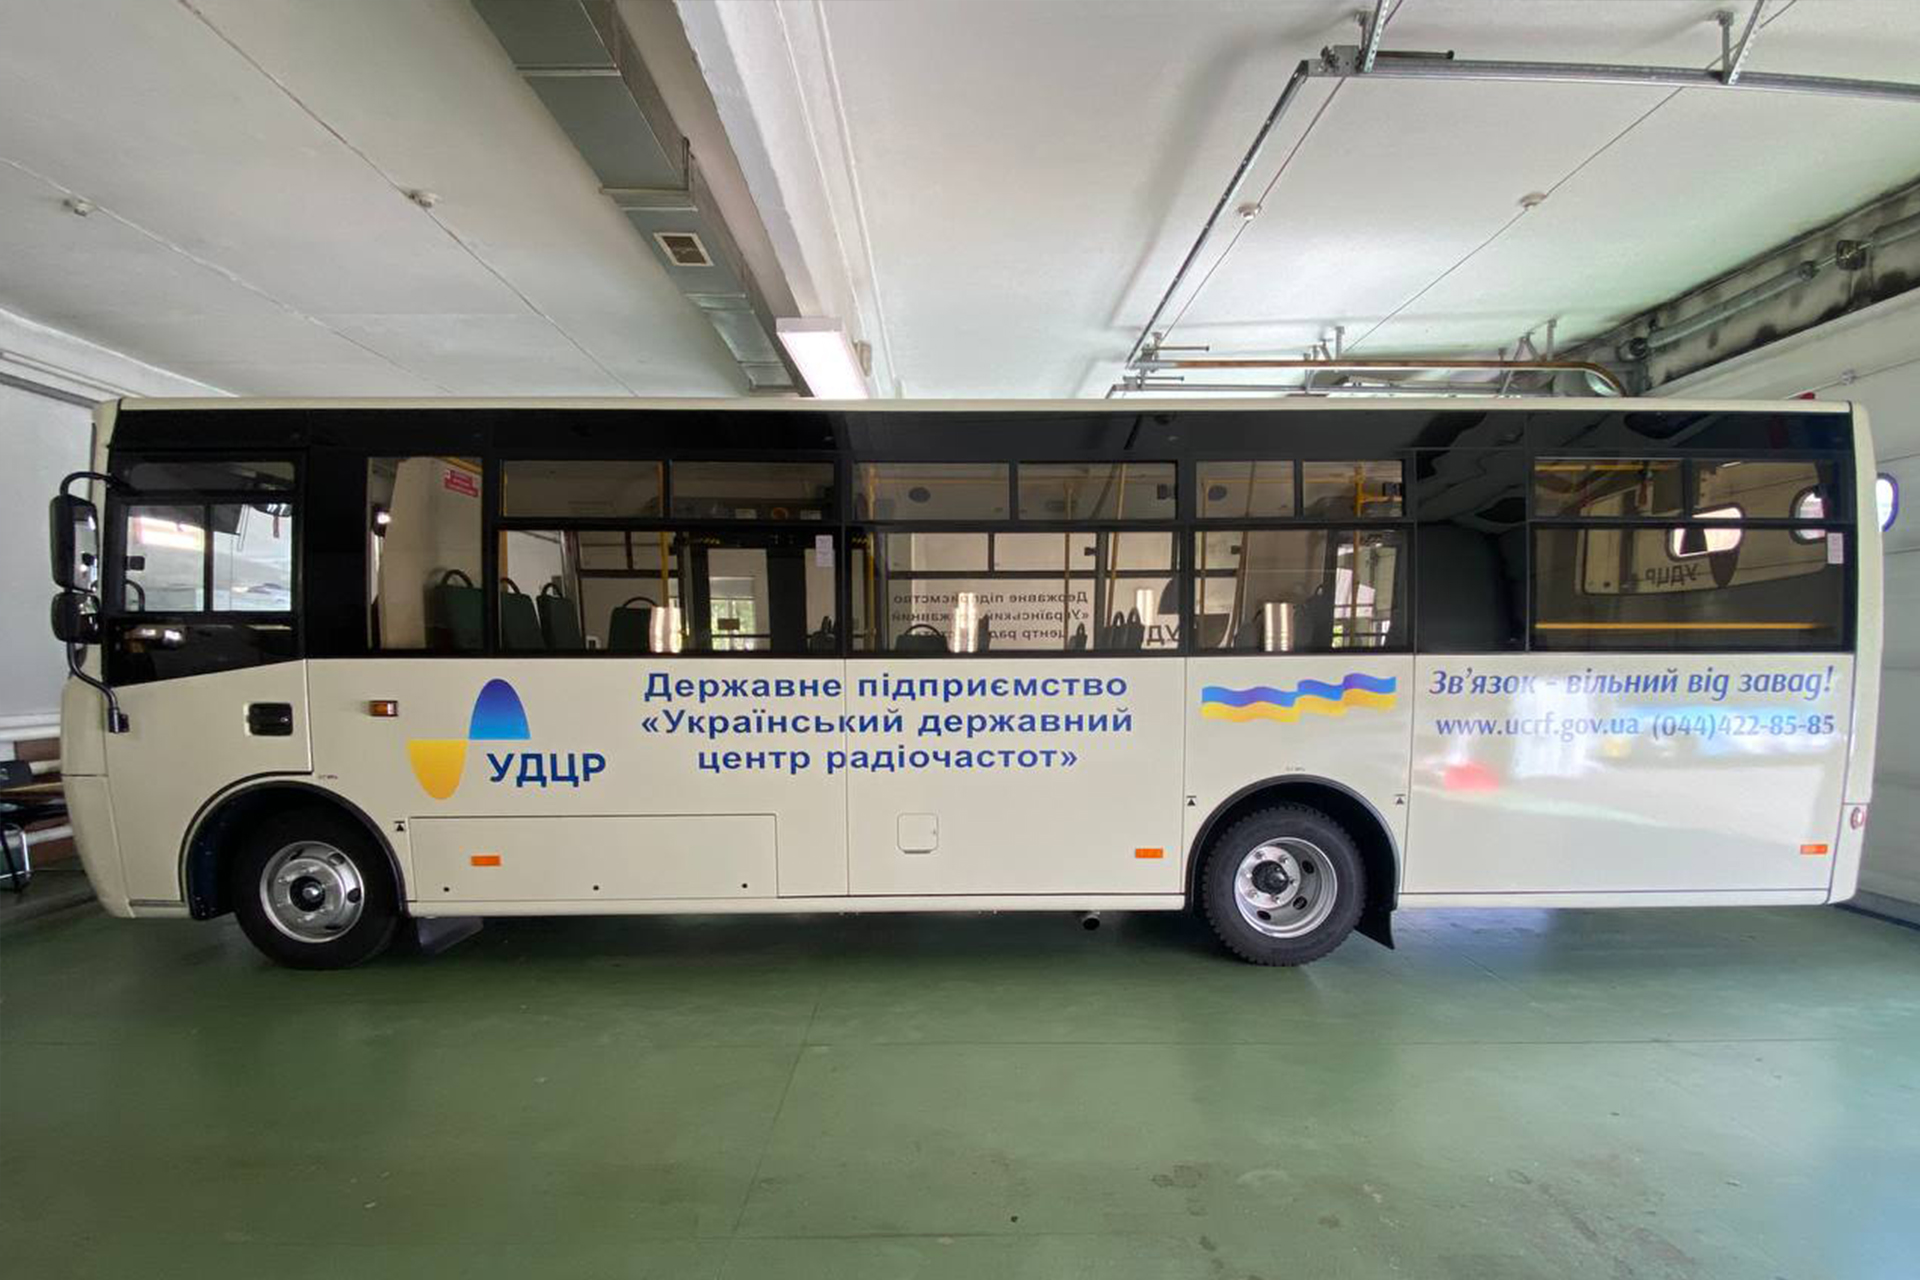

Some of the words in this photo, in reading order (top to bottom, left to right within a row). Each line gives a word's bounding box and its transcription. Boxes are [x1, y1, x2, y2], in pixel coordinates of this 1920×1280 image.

[643, 672, 842, 703] Державне
[857, 672, 1128, 703] підприємство
[1566, 667, 1678, 694] вільний
[1687, 667, 1730, 701] від
[1738, 665, 1835, 701] завад!
[641, 707, 904, 739] «Український
[918, 706, 1134, 739] державний
[1436, 711, 1639, 740] www.ucrf.gov.ua
[1652, 713, 1835, 740] (044)422-85-85
[486, 753, 606, 788] УДЦР
[698, 748, 811, 775] центр
[826, 745, 1079, 775] радіочастот»
